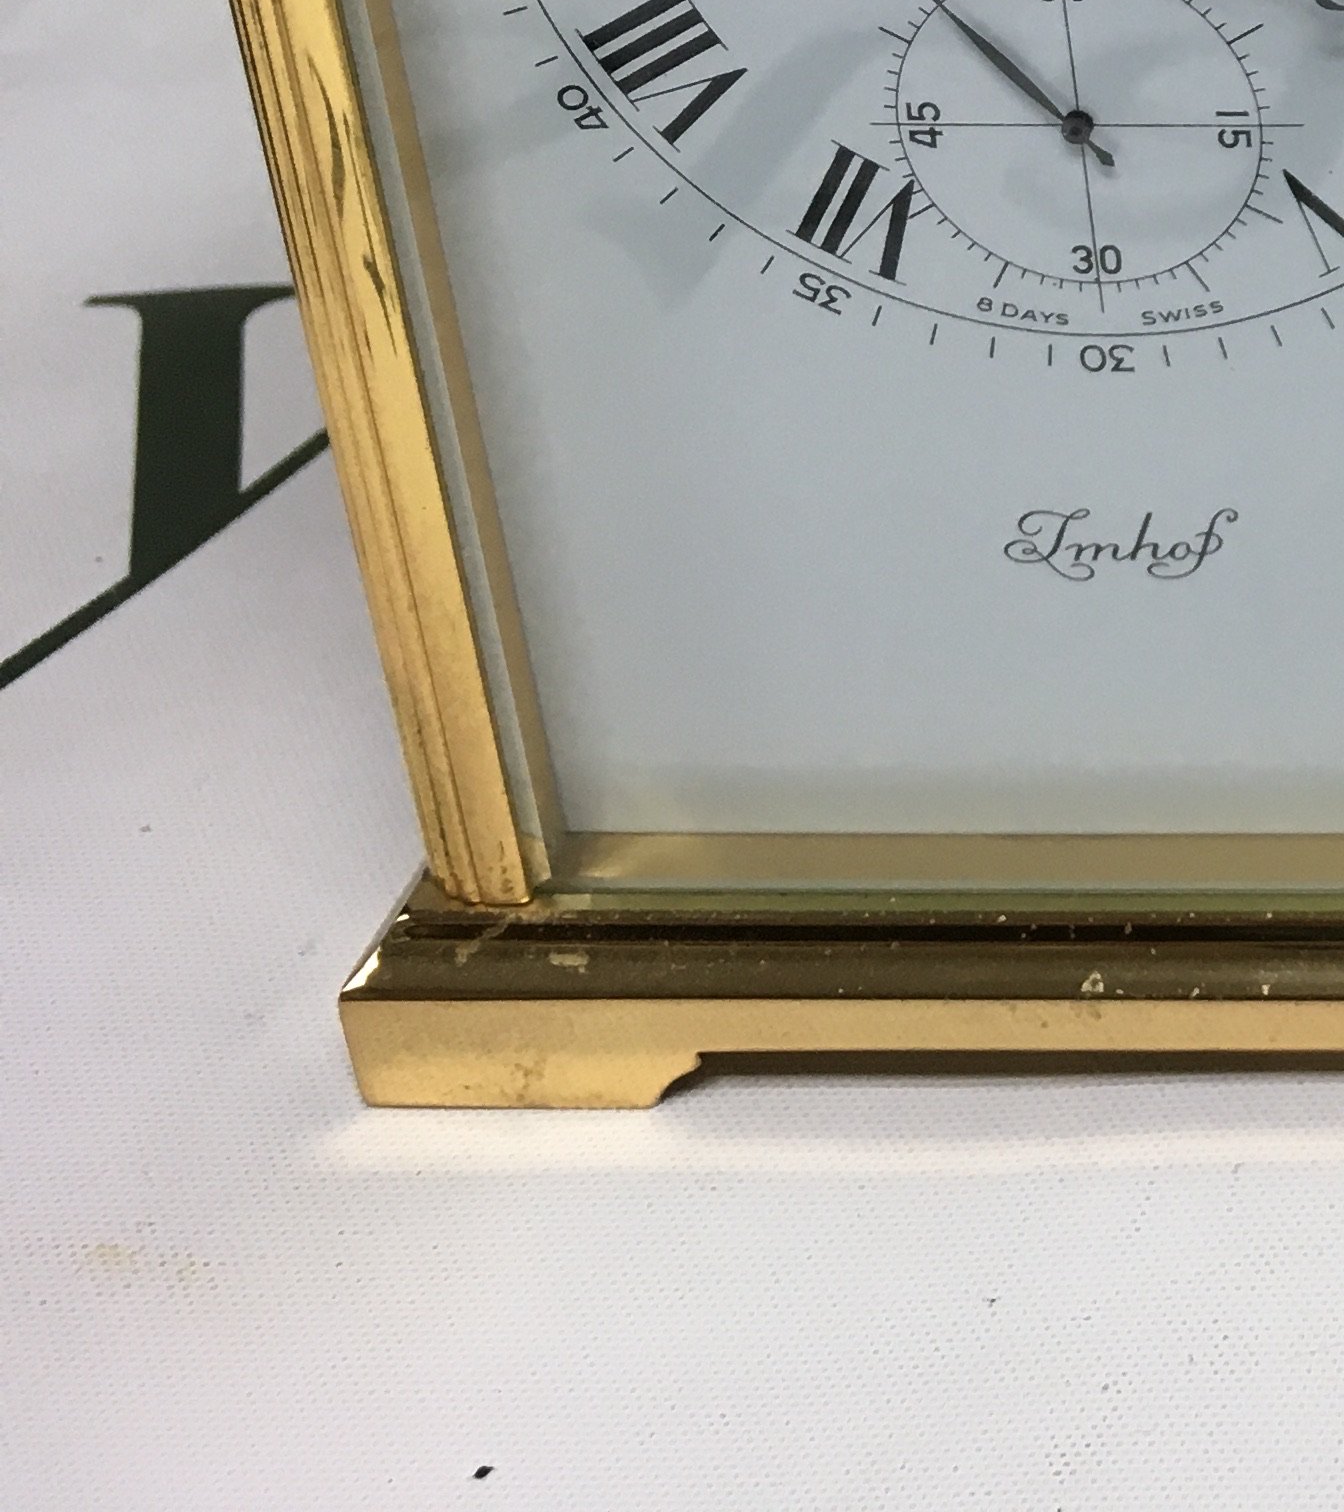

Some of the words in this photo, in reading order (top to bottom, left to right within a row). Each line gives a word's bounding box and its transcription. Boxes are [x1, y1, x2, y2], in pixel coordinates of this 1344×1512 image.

[557, 84, 610, 131] 40
[906, 101, 943, 149] 45
[1215, 110, 1252, 149] 15
[786, 140, 915, 286] VII
[1071, 245, 1122, 275] 30
[792, 272, 853, 316] 35
[977, 297, 994, 313] 8
[1001, 303, 1070, 326] DAYS
[1142, 301, 1225, 326] SWISS
[1079, 343, 1135, 373] 30
[1003, 508, 1239, 582] Imhof
